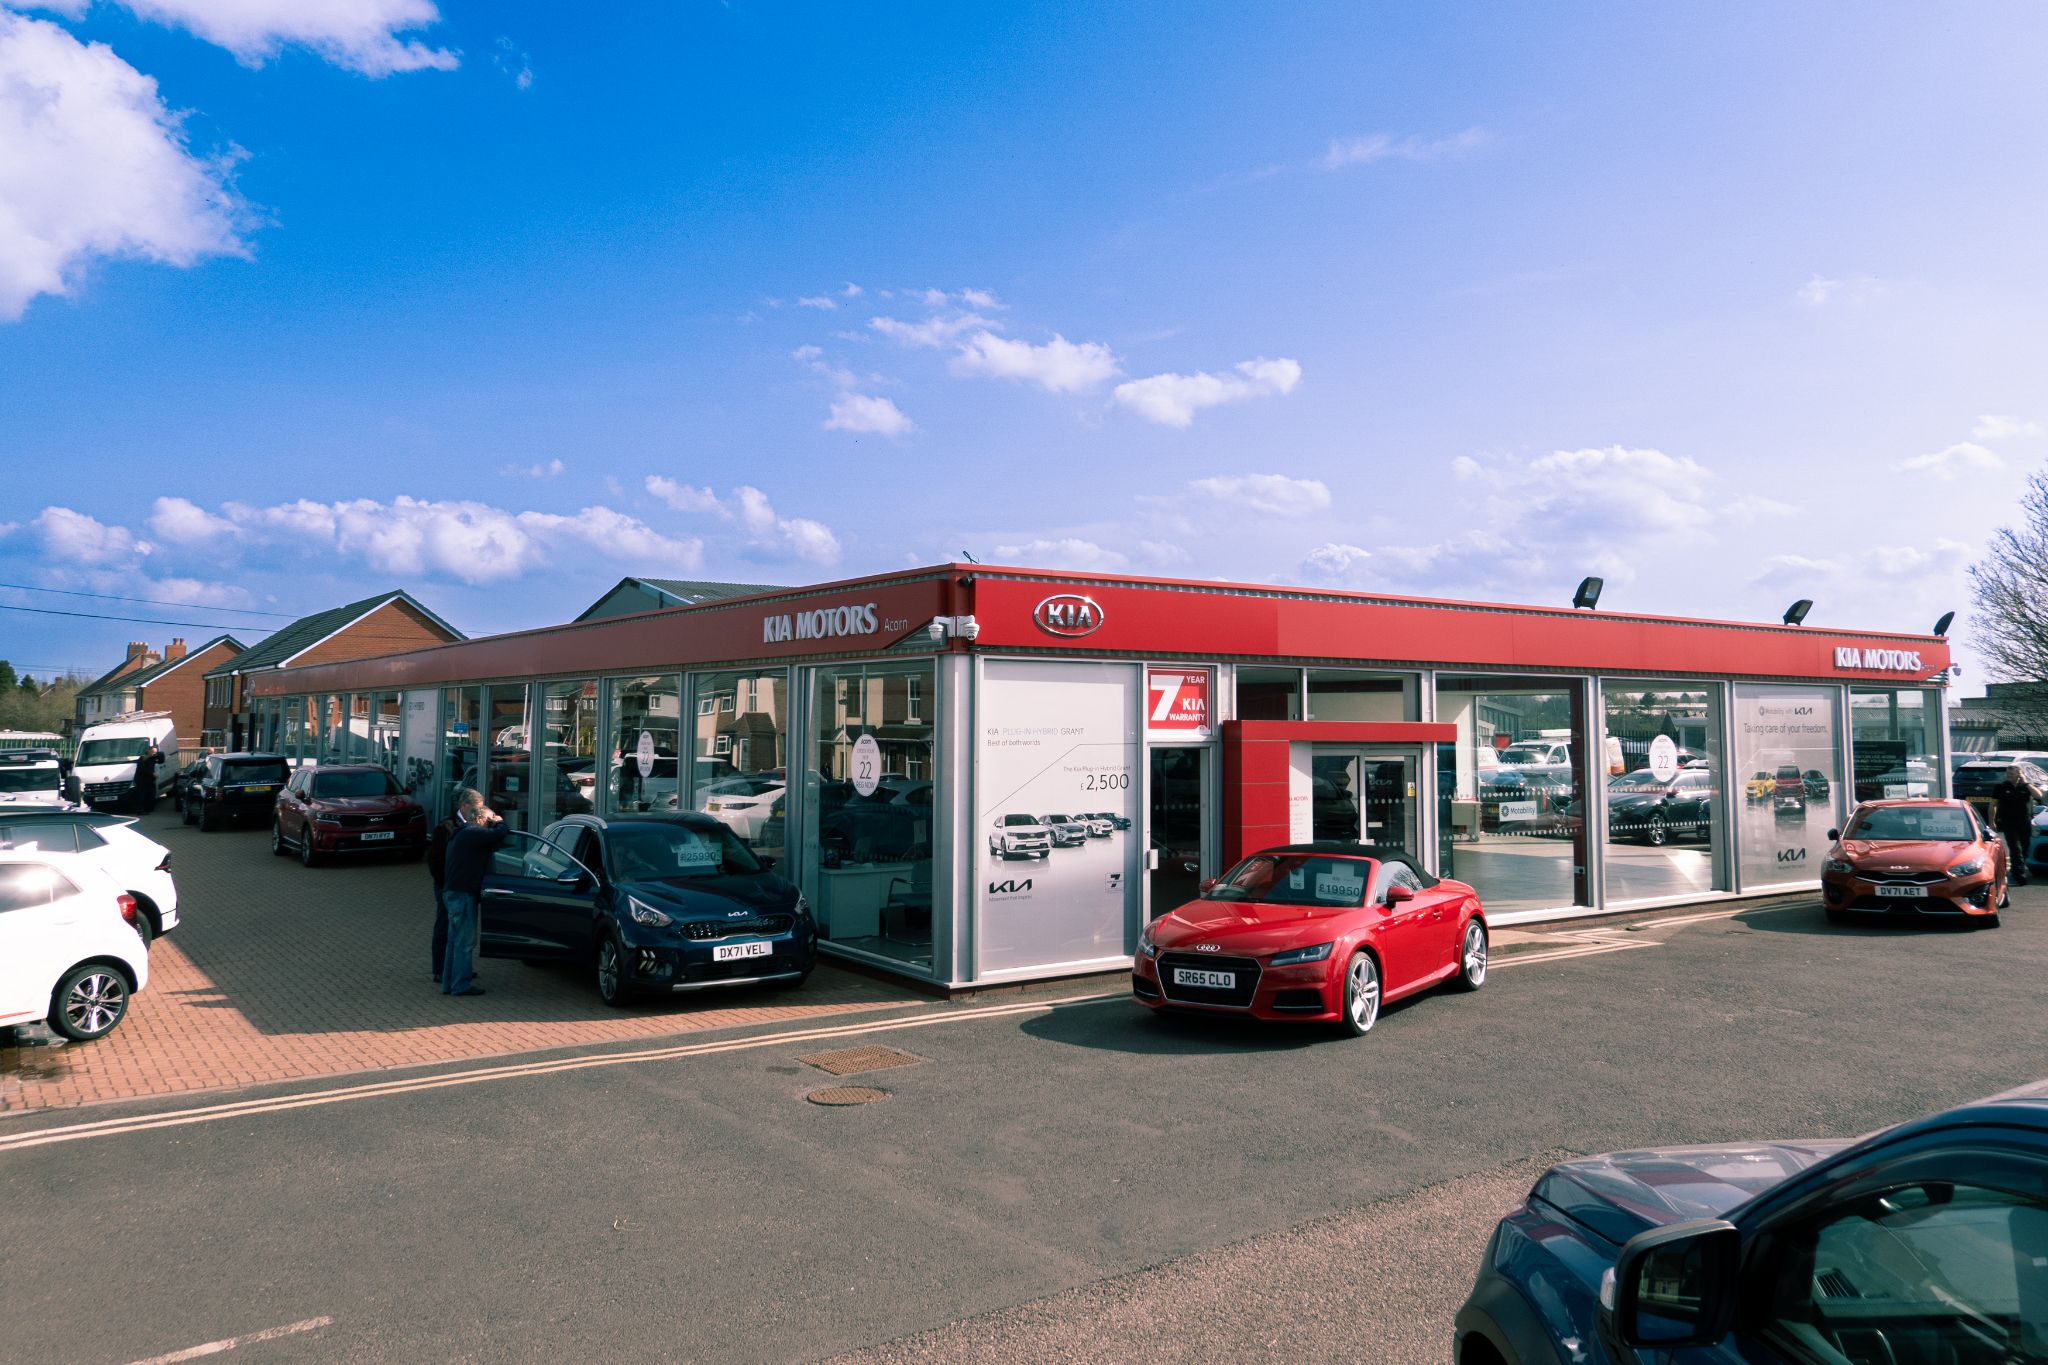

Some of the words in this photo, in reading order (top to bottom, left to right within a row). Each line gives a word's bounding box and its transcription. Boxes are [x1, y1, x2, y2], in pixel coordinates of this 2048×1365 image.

[1046, 603, 1093, 627] KIA
[763, 614, 794, 643] KIA
[796, 602, 879, 640] MOTORS
[884, 618, 908, 632] Acorn
[1834, 646, 1862, 668] KIA
[1863, 648, 1921, 671] MOTORS
[1186, 675, 1205, 684] YEAR
[1150, 674, 1185, 721] 7
[1182, 697, 1206, 711] KIA
[1169, 713, 1206, 721] WARRANTY
[1794, 707, 1813, 715] KIA
[987, 727, 999, 735] KIA
[1002, 727, 1032, 736] PLUG-IN
[1032, 727, 1059, 735] HYBRID
[1060, 727, 1085, 735] GRANT
[1744, 723, 1764, 735] Taking
[1765, 725, 1778, 733] care
[1780, 723, 1786, 733] of
[1787, 725, 1801, 735] your
[987, 739, 1000, 747] Best
[1658, 755, 1669, 769] 22
[859, 761, 872, 779] 22
[1510, 807, 1536, 815] Motability
[1778, 847, 1806, 862] KIA
[989, 878, 1033, 894] KIA
[1319, 883, 1360, 897] £19950
[1880, 887, 1901, 896] DV71
[1903, 887, 1921, 895] AET
[720, 946, 743, 958] DX71
[745, 944, 766, 956] VEL
[1178, 970, 1206, 984] SR65
[1208, 973, 1231, 987] CLO
